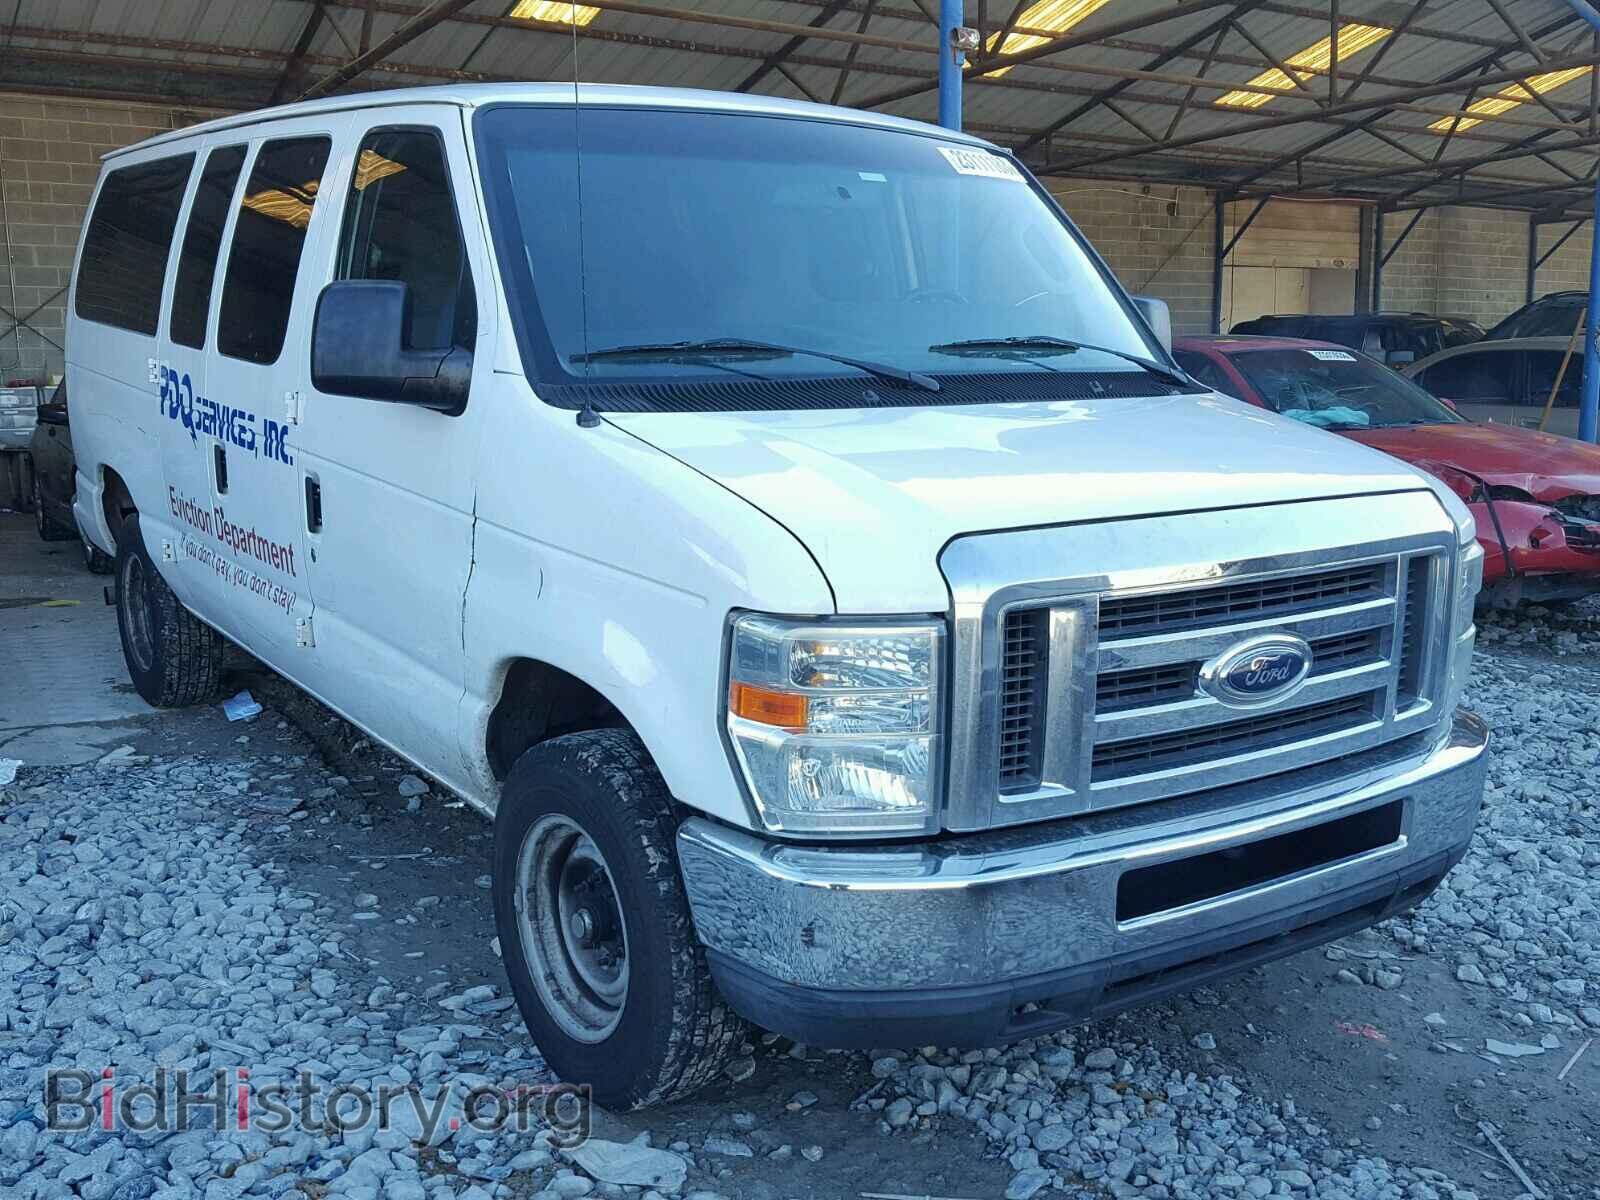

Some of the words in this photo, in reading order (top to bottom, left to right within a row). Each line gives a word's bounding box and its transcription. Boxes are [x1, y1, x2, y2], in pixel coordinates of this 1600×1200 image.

[160, 365, 197, 442] PDQ
[263, 418, 294, 466] INC.
[169, 485, 213, 537] Eviction
[213, 506, 297, 578] Department
[185, 540, 198, 558] you
[233, 567, 249, 586] you
[250, 571, 273, 601] don't
[1245, 656, 1292, 686] Ford
